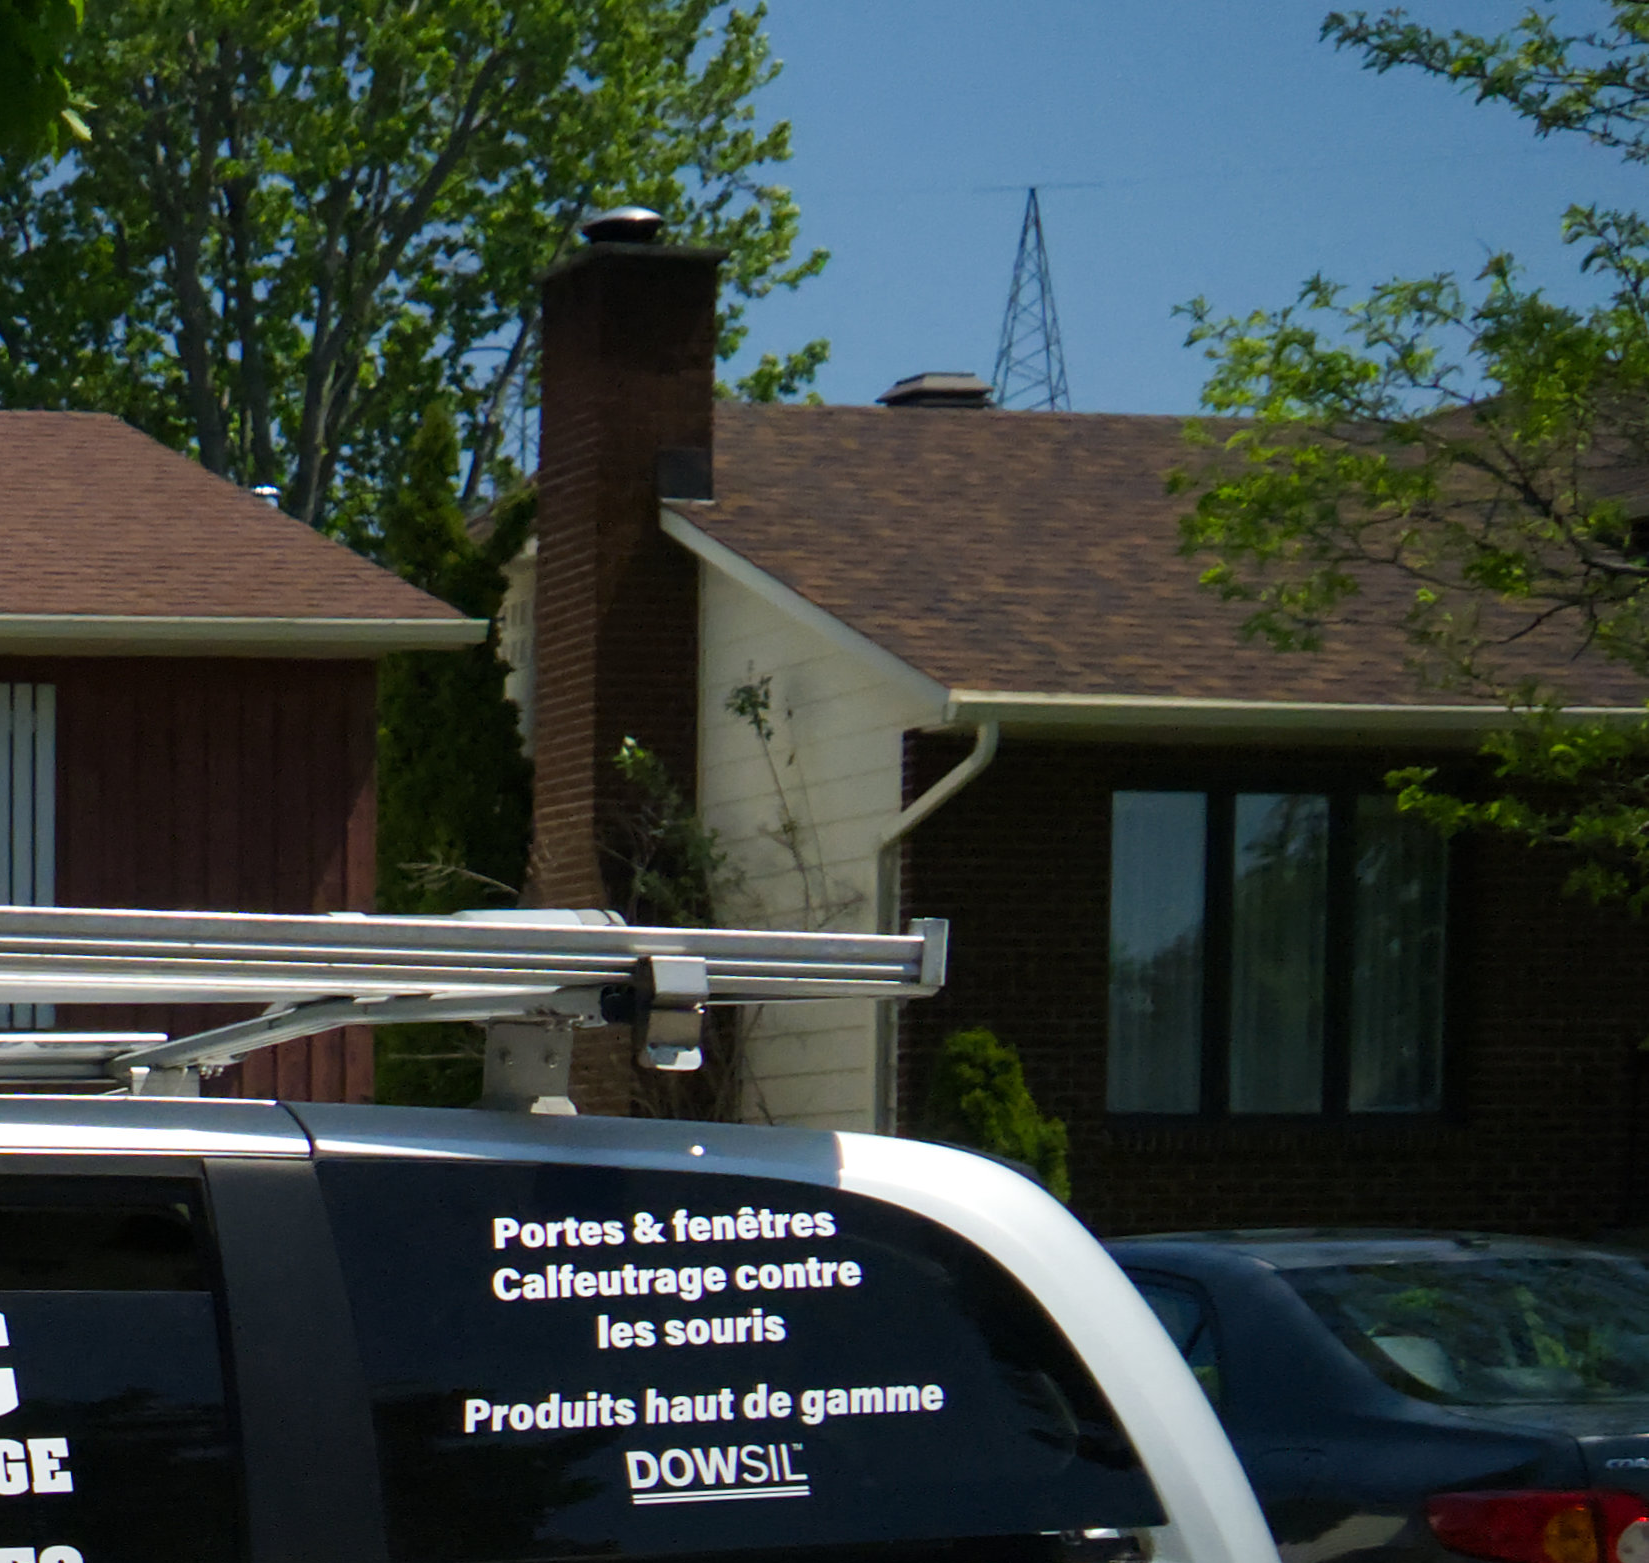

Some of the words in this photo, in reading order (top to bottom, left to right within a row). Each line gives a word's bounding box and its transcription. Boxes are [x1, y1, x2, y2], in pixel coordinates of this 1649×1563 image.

[494, 1217, 624, 1249] Portes
[633, 1212, 666, 1243] &
[672, 1207, 835, 1241] fenêtres
[493, 1264, 726, 1301] Calfeutrage
[735, 1257, 861, 1290] contre
[598, 1315, 656, 1348] les
[665, 1308, 785, 1345] souris
[465, 1392, 636, 1433] Produits
[646, 1388, 734, 1424] haut
[743, 1384, 792, 1419] de
[801, 1385, 943, 1424] gamme
